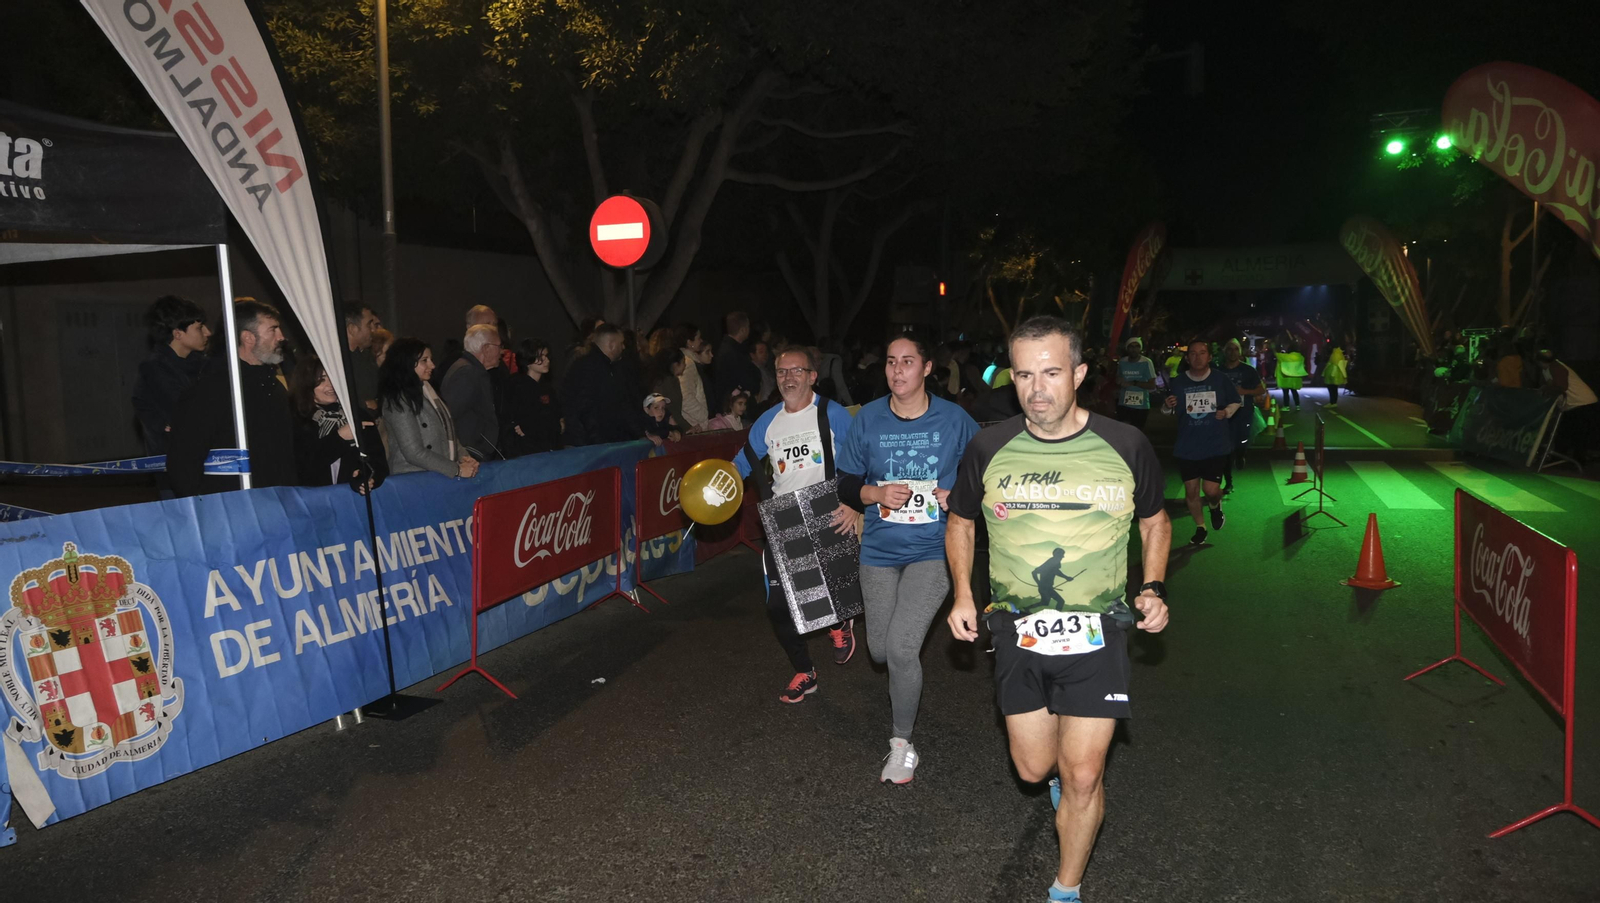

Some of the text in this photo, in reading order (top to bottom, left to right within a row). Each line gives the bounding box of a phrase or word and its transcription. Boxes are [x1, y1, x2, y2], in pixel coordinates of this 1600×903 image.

[1193, 398, 1210, 406] 718
[889, 433, 900, 441] SAN
[901, 432, 929, 440] SILVESTRE
[783, 444, 810, 460] 706
[1020, 470, 1065, 486] TRAIL
[1002, 484, 1060, 501] CABO
[1075, 485, 1126, 501] GATA
[514, 488, 597, 568] Coca-Cola
[1470, 522, 1536, 640] Coca-Cola
[26, 618, 34, 627] Y
[154, 606, 165, 625] POR
[209, 568, 454, 678] DE ALMERÍA
[161, 627, 170, 640] LA
[1034, 614, 1082, 638] 643
[160, 643, 171, 686] LIBERTAD
[3, 670, 22, 702] NOBLE
[19, 702, 39, 721] MUY
[71, 755, 109, 775] CIUDAD
[109, 749, 122, 761] DE
